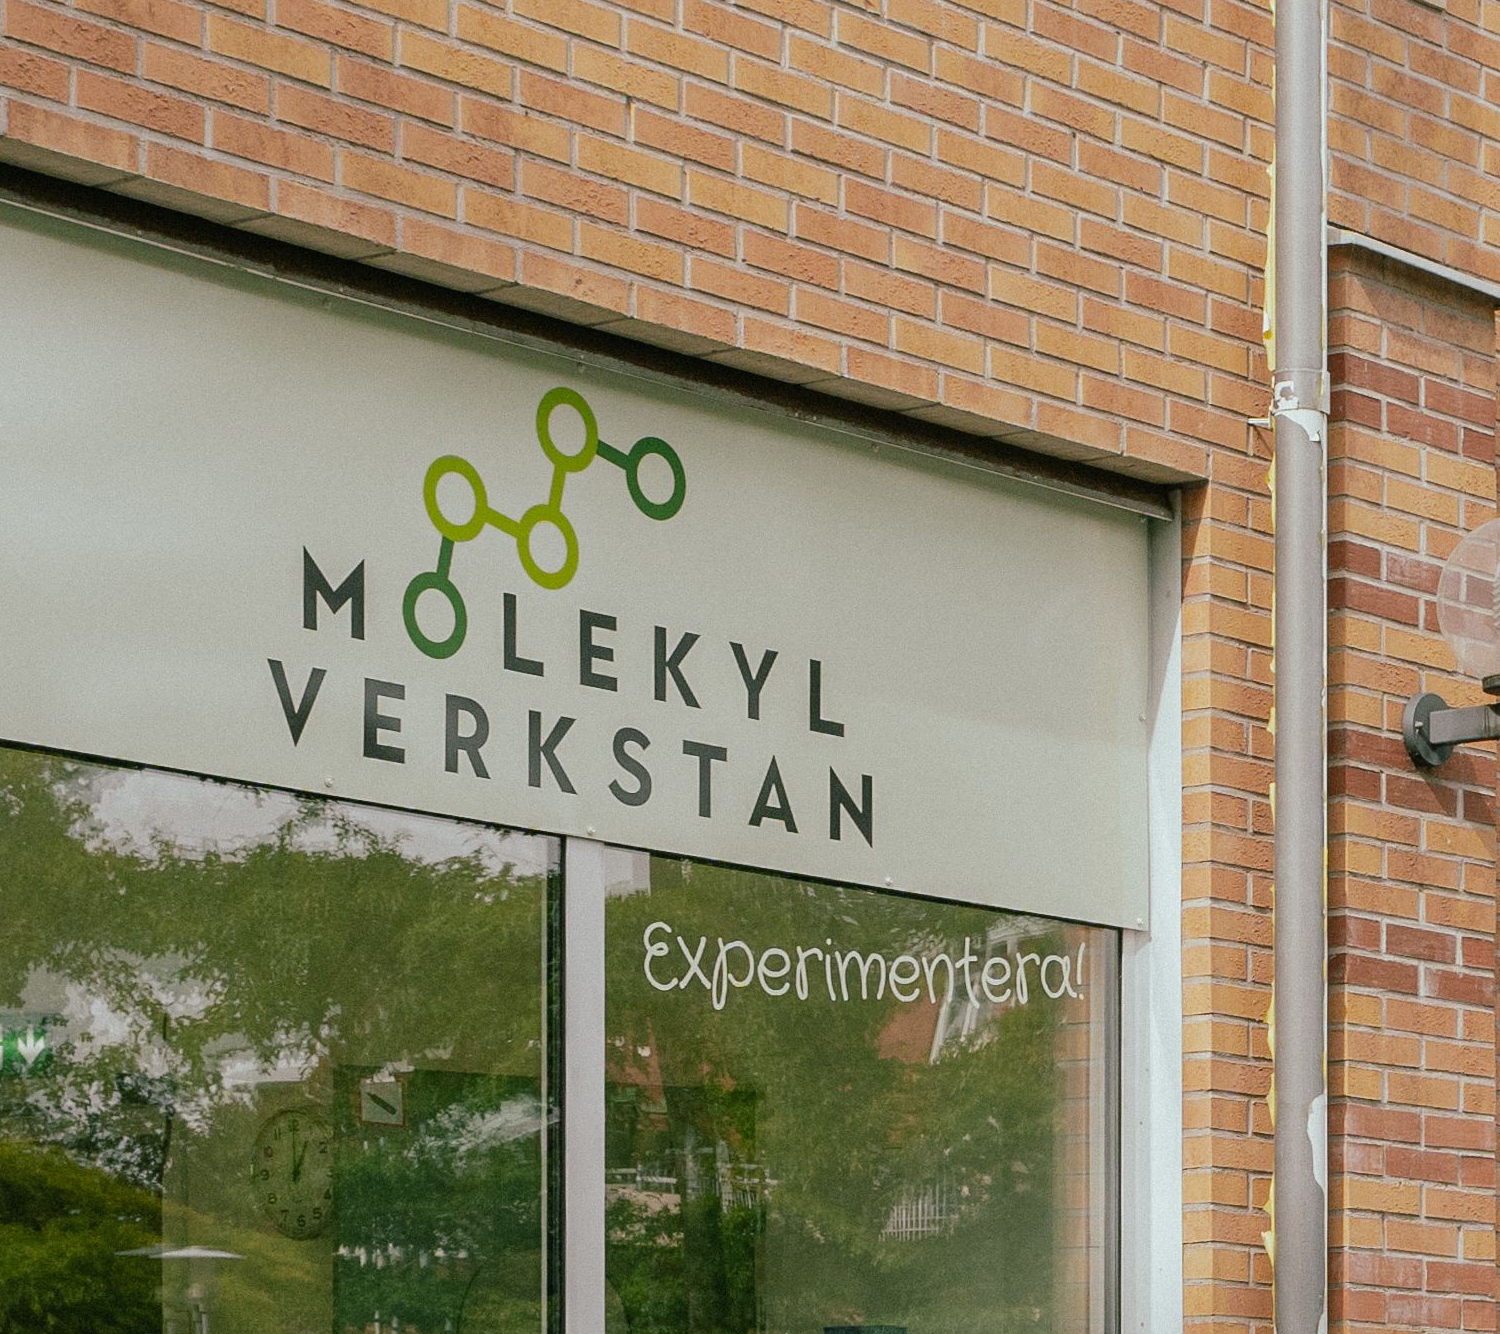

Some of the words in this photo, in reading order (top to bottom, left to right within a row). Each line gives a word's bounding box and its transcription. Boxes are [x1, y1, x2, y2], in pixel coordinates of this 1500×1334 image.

[303, 545, 846, 738] MOLEKYL
[267, 658, 875, 850] VERKSTAN
[642, 920, 1086, 1011] Experimentera!
